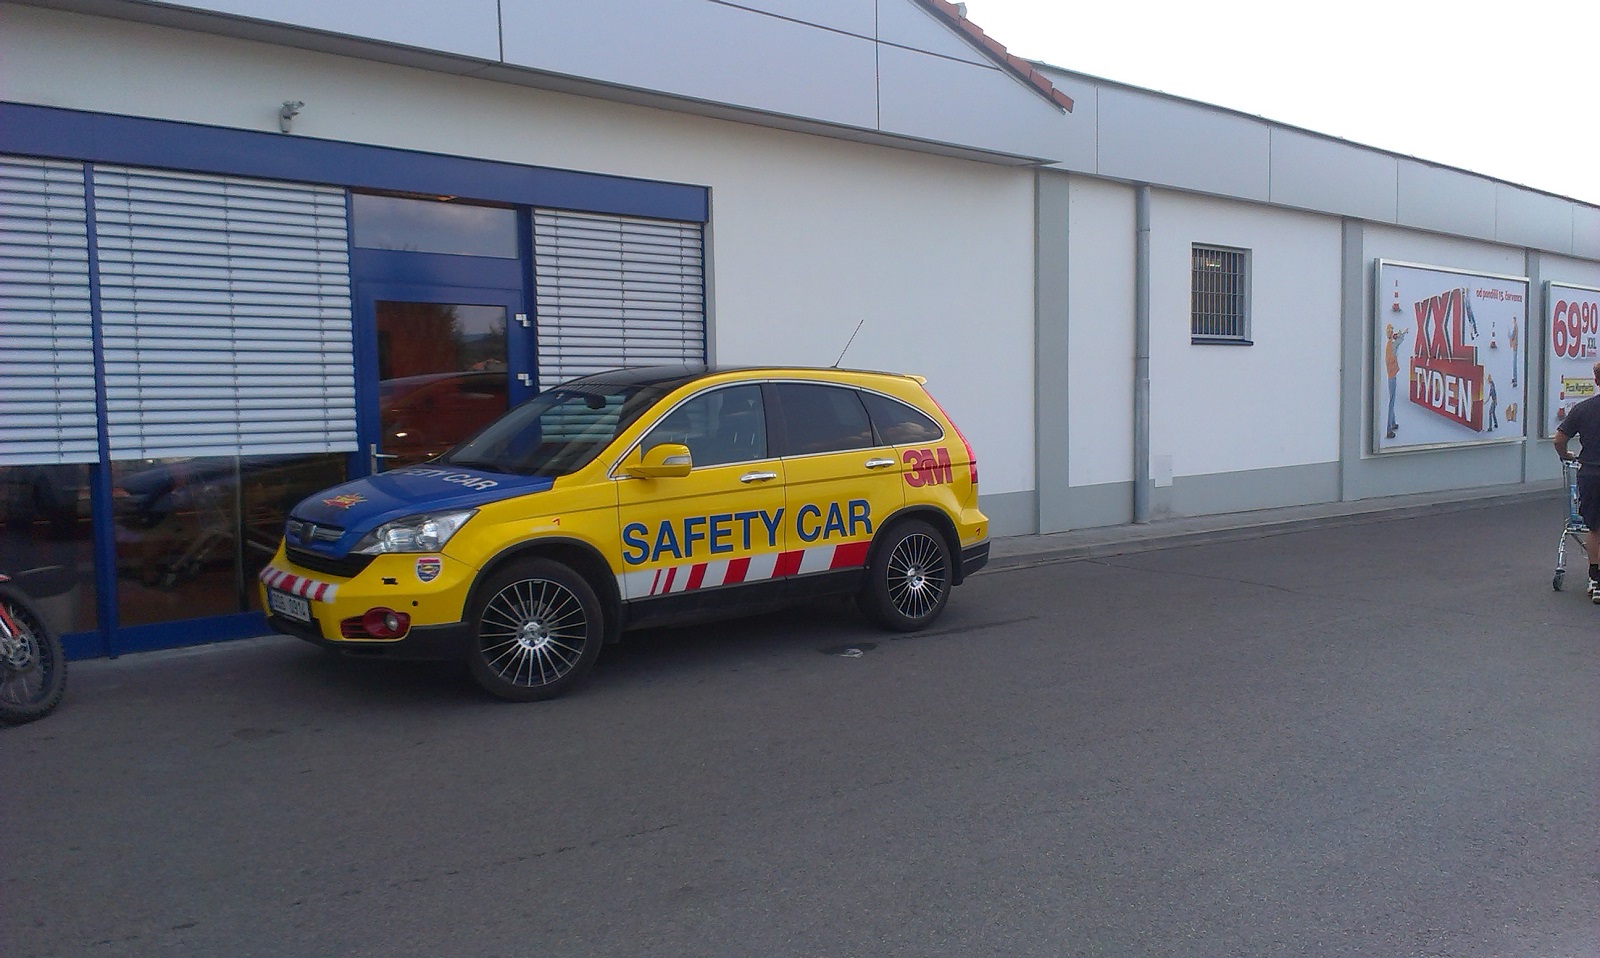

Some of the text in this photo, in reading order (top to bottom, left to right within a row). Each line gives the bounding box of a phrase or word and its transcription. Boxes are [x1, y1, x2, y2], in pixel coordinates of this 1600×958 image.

[1414, 288, 1476, 361] XXL
[442, 473, 499, 491] CAR
[903, 447, 953, 488] 3M
[622, 499, 873, 566] SAFETY CAR
